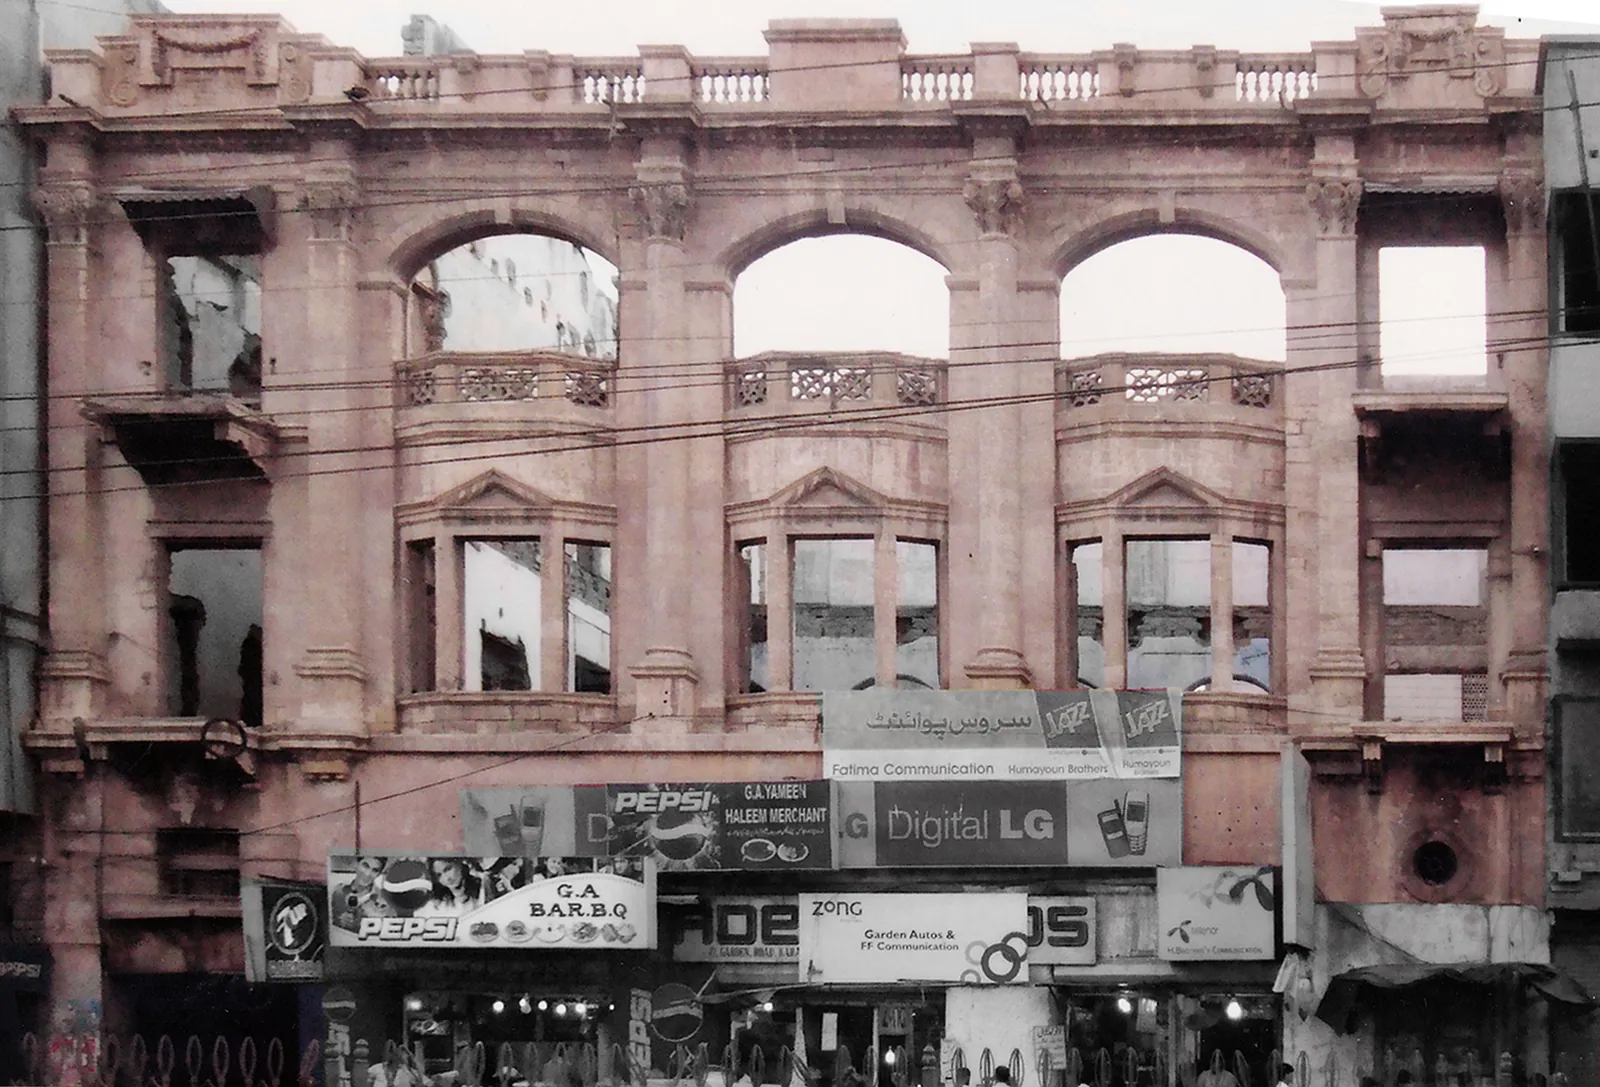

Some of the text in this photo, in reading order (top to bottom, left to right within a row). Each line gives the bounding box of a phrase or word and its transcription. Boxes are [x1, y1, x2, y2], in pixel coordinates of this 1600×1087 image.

[832, 763, 995, 776] Fatima Communication
[1008, 764, 1109, 774] Humayoun Brothers
[615, 791, 712, 813] PEPSI
[725, 807, 827, 824] HALEEM MERCHANT
[888, 808, 1054, 848] Digital LG
[557, 884, 600, 899] G.A
[530, 903, 628, 919] BAR.B.Q
[358, 917, 457, 941] PEPSI
[864, 929, 955, 940] Garden Autos &
[860, 941, 959, 952] FF Communication
